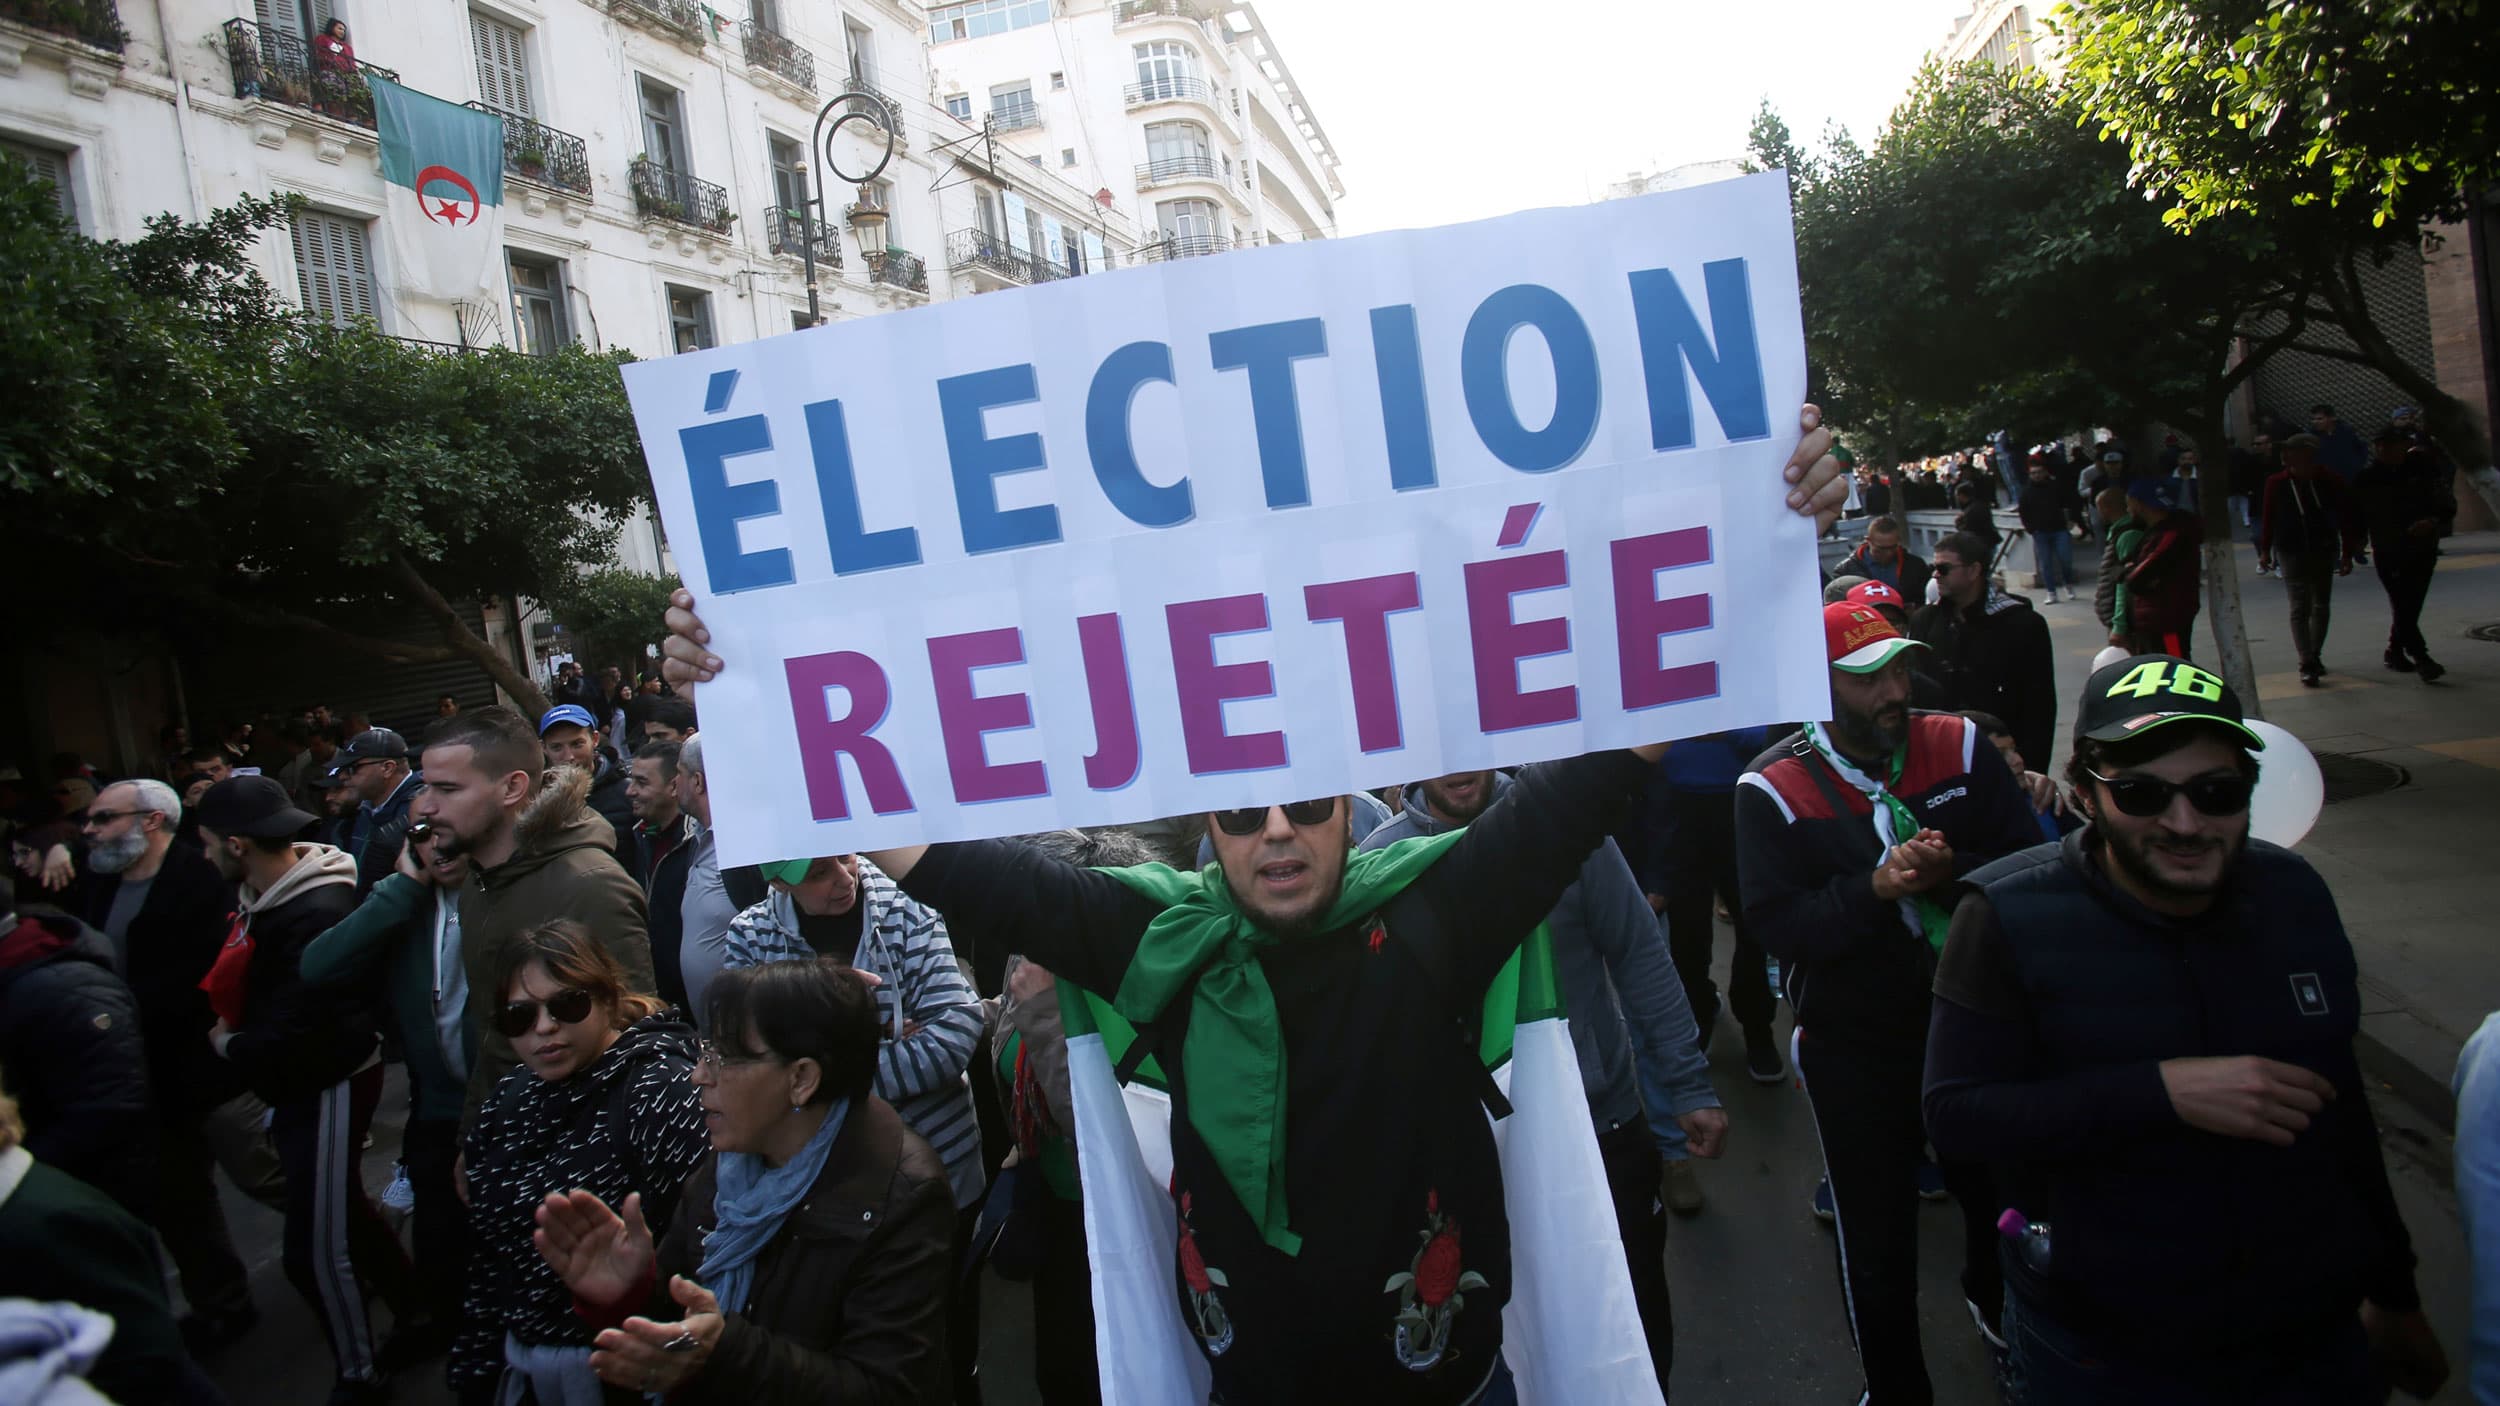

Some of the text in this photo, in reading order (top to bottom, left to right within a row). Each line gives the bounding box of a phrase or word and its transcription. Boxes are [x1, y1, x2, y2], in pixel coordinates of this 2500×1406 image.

[679, 257, 1772, 597] ÉLECTION
[785, 502, 1720, 822] REJETÉE
[2106, 661, 2224, 702] 46
